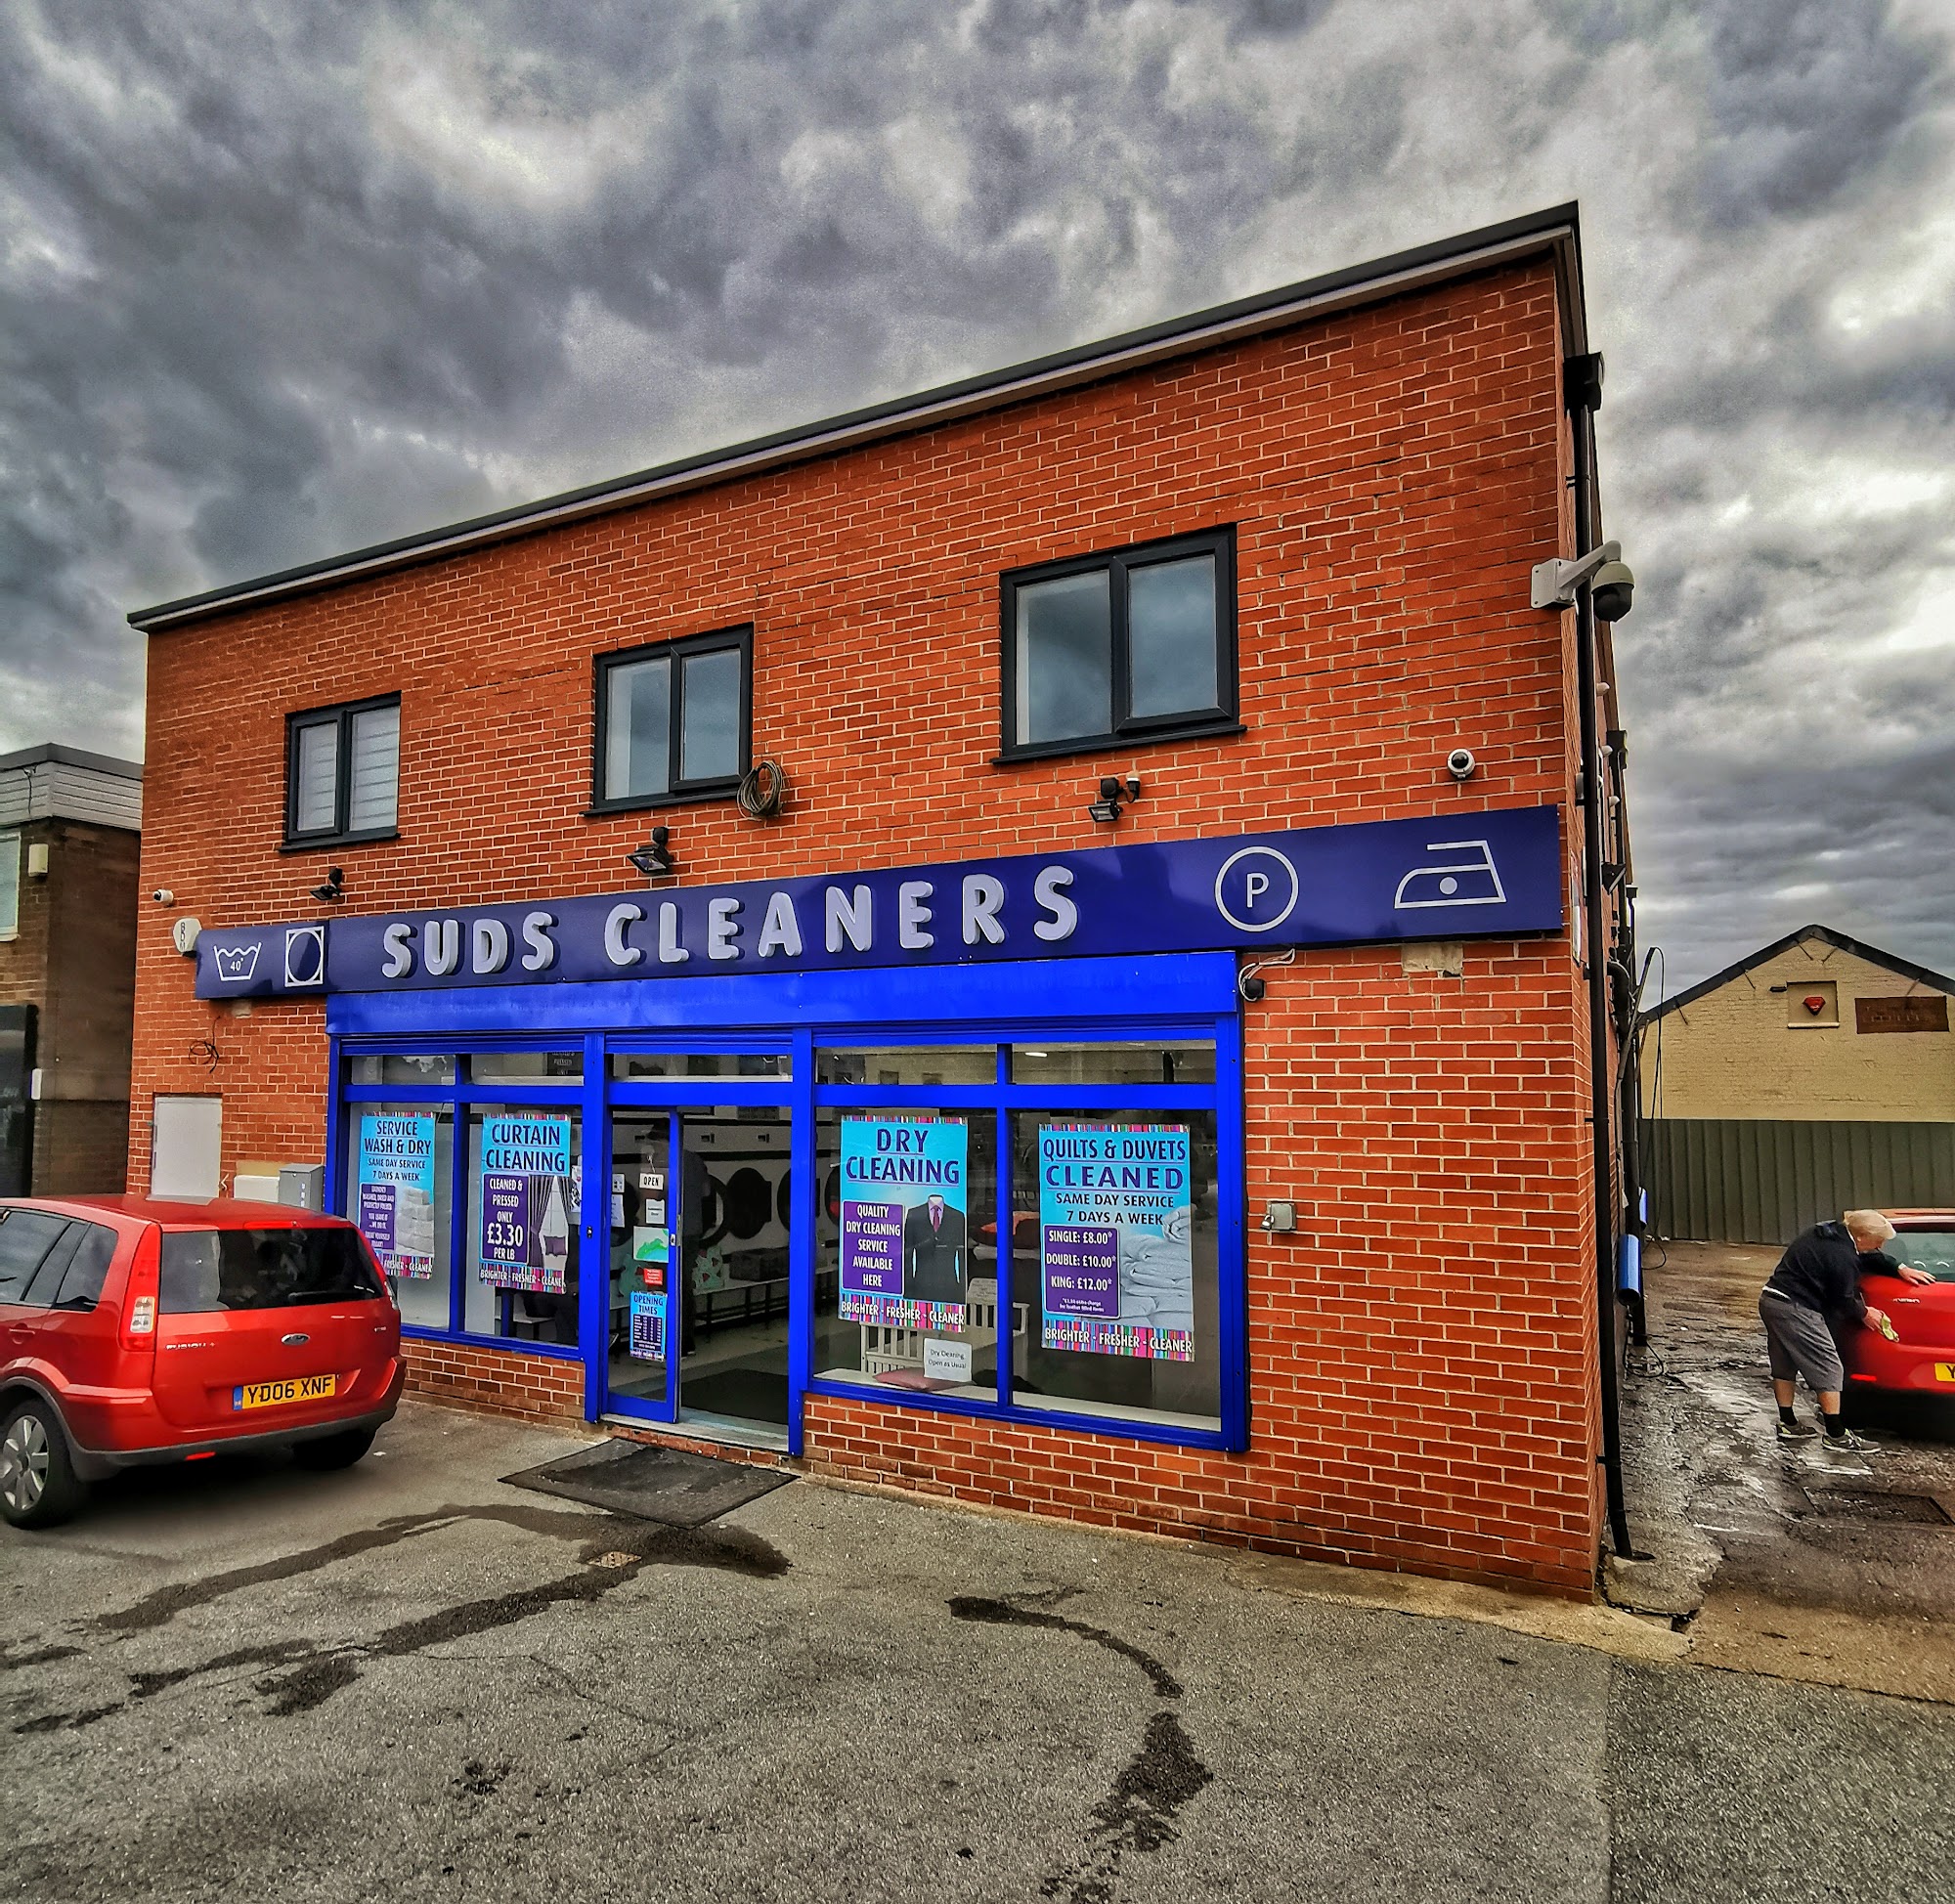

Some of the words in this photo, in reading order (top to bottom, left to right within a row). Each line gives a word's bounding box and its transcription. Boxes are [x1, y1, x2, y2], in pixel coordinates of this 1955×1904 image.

[1246, 873, 1270, 908] P
[382, 912, 554, 978] SUDS
[604, 865, 1077, 966] CLEANERS
[376, 1120, 418, 1136] SERVICE
[492, 1124, 560, 1146] CURTAIN
[364, 1138, 392, 1153] WASH
[396, 1139, 405, 1154] &
[408, 1140, 431, 1155] DRY
[876, 1128, 929, 1152] DRY
[1043, 1139, 1098, 1162] QUILTS
[1104, 1141, 1116, 1158] &
[1123, 1140, 1186, 1160] DUVETS
[368, 1157, 384, 1168] SAME
[385, 1158, 398, 1168] DAY
[399, 1158, 425, 1169] SERVICE
[486, 1148, 565, 1172] CLEANING
[372, 1170, 377, 1179] 7
[377, 1170, 393, 1181] DAYS
[394, 1171, 400, 1181] A
[401, 1172, 419, 1181] WEEK
[846, 1155, 959, 1185] CLEANING
[1046, 1165, 1183, 1190] CLEANED
[489, 1178, 516, 1190] CLEANED
[517, 1180, 523, 1191] &
[643, 1176, 660, 1187] OPEN
[492, 1194, 519, 1207] PRESSED
[1056, 1192, 1090, 1205] SAME
[1094, 1194, 1119, 1206] DAY
[1123, 1194, 1174, 1208] SERVICE
[497, 1211, 513, 1223] ONLY
[856, 1203, 890, 1219] QUALITY
[1066, 1210, 1072, 1222] 7
[1078, 1211, 1110, 1224] DAYS
[1114, 1212, 1124, 1224] A
[1127, 1213, 1163, 1226] WEEK
[487, 1223, 524, 1247] £3.30
[846, 1220, 862, 1234] DRY
[863, 1222, 901, 1236] CLEANING
[1049, 1230, 1080, 1243] SINGLE:
[857, 1238, 889, 1253] SERVICE
[494, 1247, 506, 1259] PER
[506, 1248, 515, 1261] LB
[1046, 1252, 1080, 1267] DOUBLE:
[852, 1256, 893, 1271] AVAILABLE
[480, 1269, 507, 1281] BRIGHTER
[511, 1272, 537, 1284] FRESHER
[862, 1274, 883, 1287] HERE
[1051, 1275, 1074, 1289] KING:
[633, 1294, 663, 1306] OPENING
[638, 1305, 658, 1315] TIMES
[841, 1301, 879, 1317] BRIGHTER
[886, 1305, 921, 1320] FRESHER
[929, 1309, 965, 1325] CLEANER
[1044, 1327, 1090, 1343] BRIGHTER
[1099, 1332, 1140, 1348] FRESHER
[1150, 1336, 1193, 1353] CLEANER
[247, 1381, 295, 1405] YD06
[300, 1376, 332, 1397] XNF
